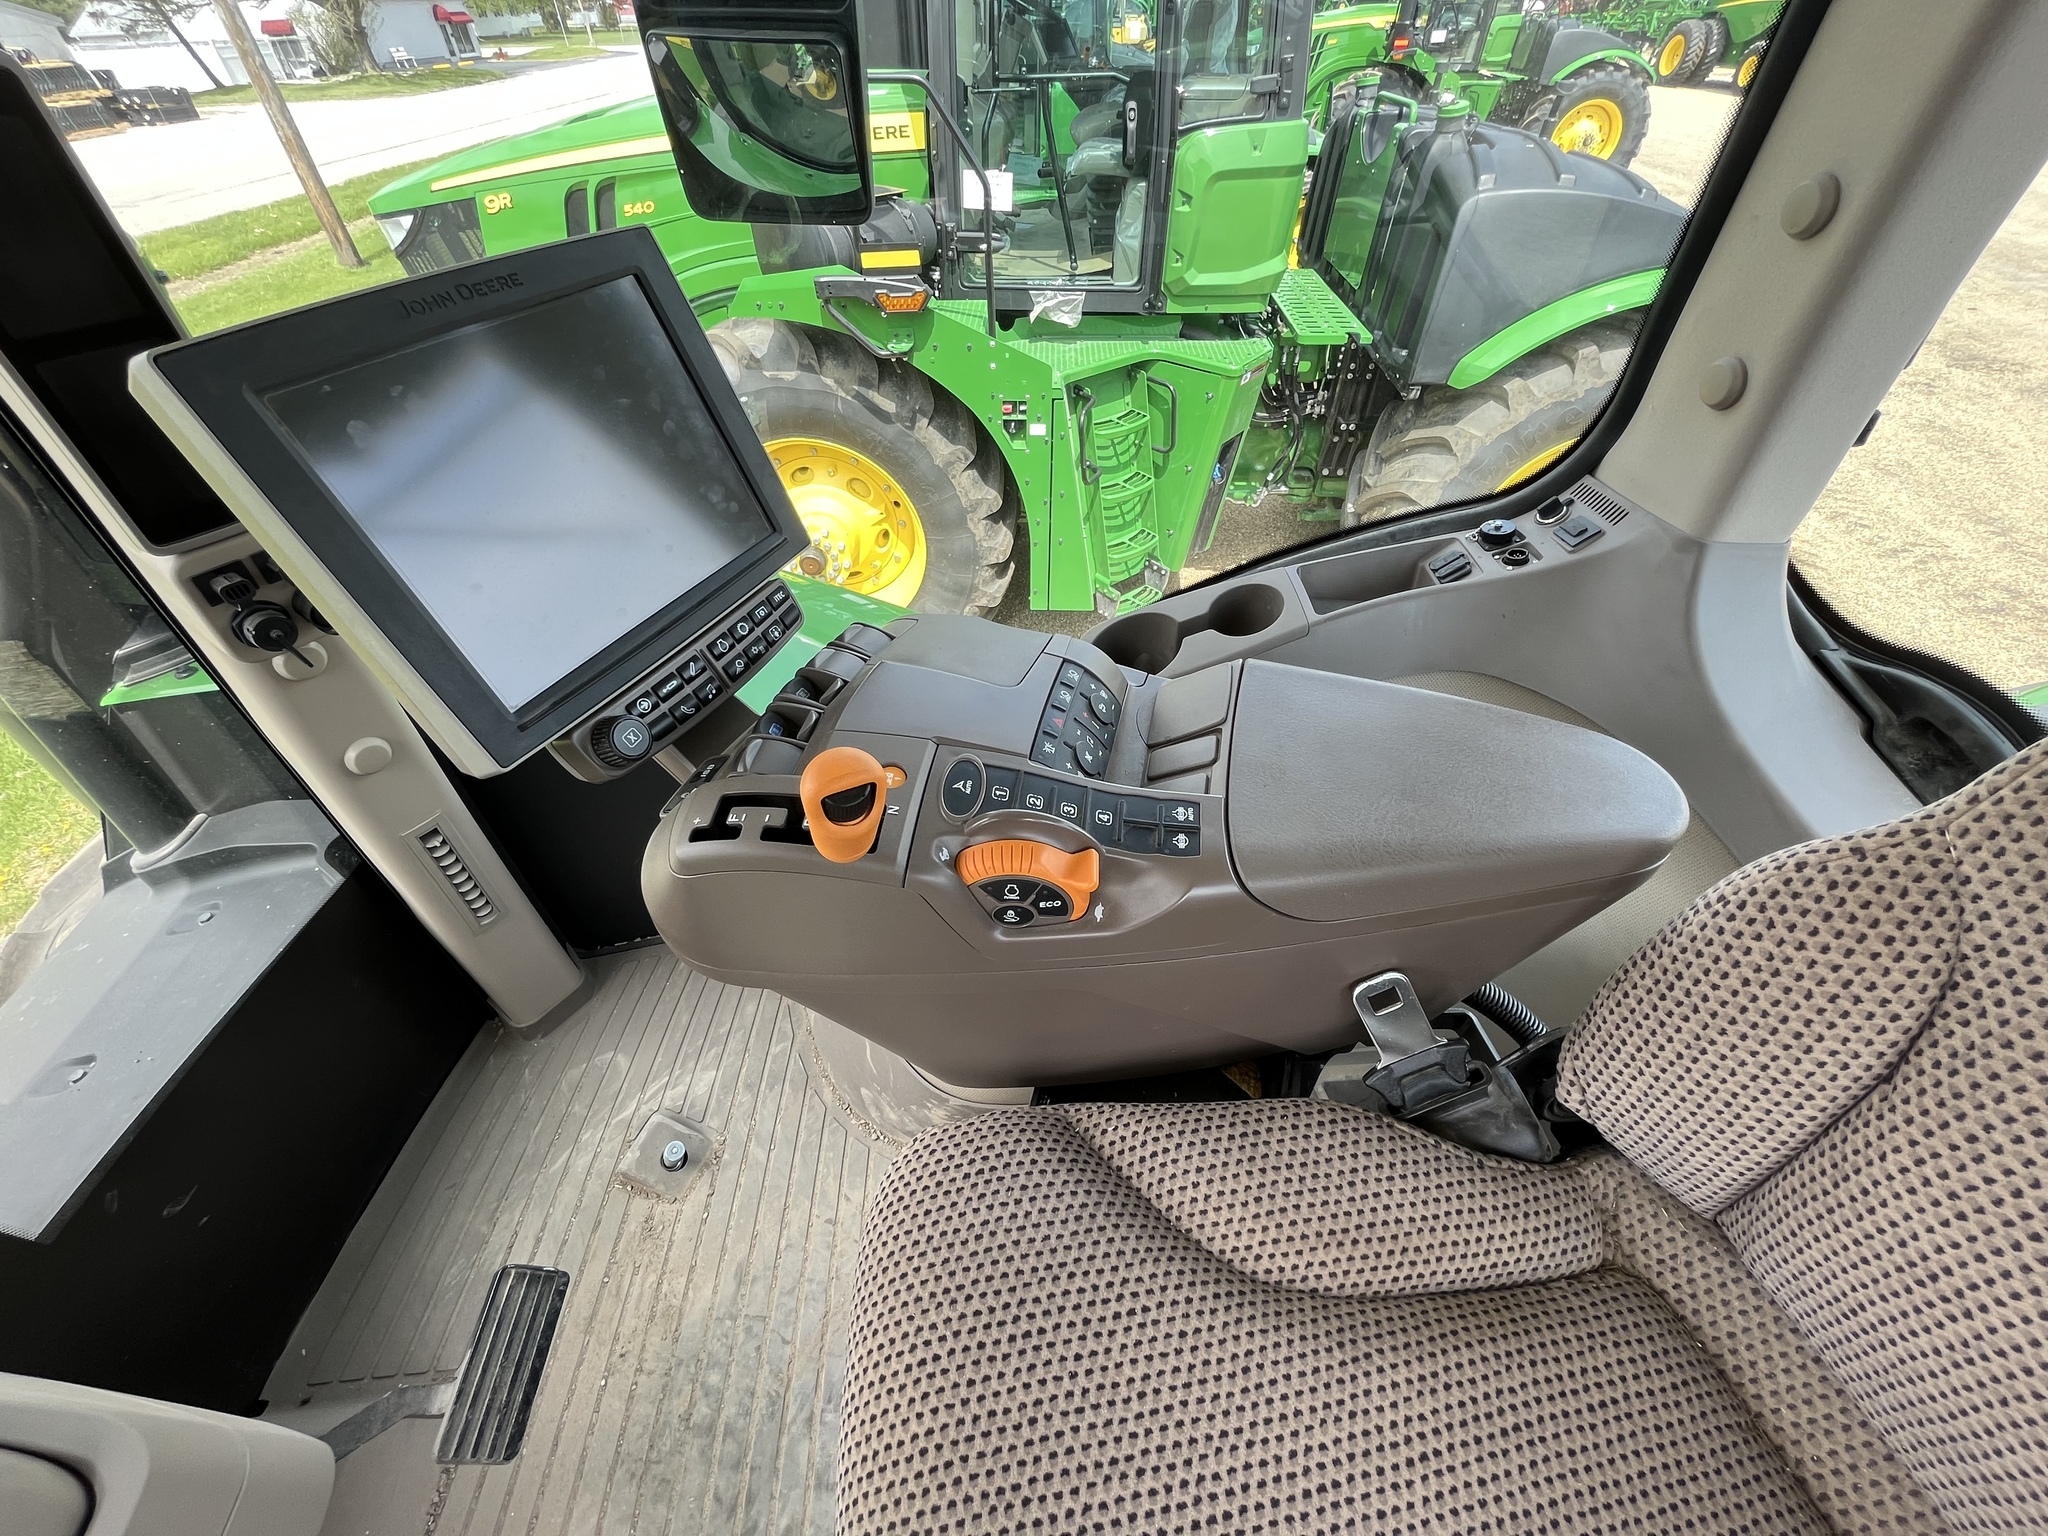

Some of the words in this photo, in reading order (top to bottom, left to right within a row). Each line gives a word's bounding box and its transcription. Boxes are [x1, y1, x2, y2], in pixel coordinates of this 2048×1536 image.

[484, 193, 513, 215] 9R
[623, 200, 655, 217] 540
[400, 290, 457, 319] JOHN
[454, 272, 524, 300] DEERE
[995, 788, 1006, 798] 1
[1031, 797, 1041, 807] 2
[887, 805, 900, 815] N
[1064, 806, 1074, 817] 3
[1099, 812, 1109, 822] 4
[1040, 901, 1061, 909] ECO
